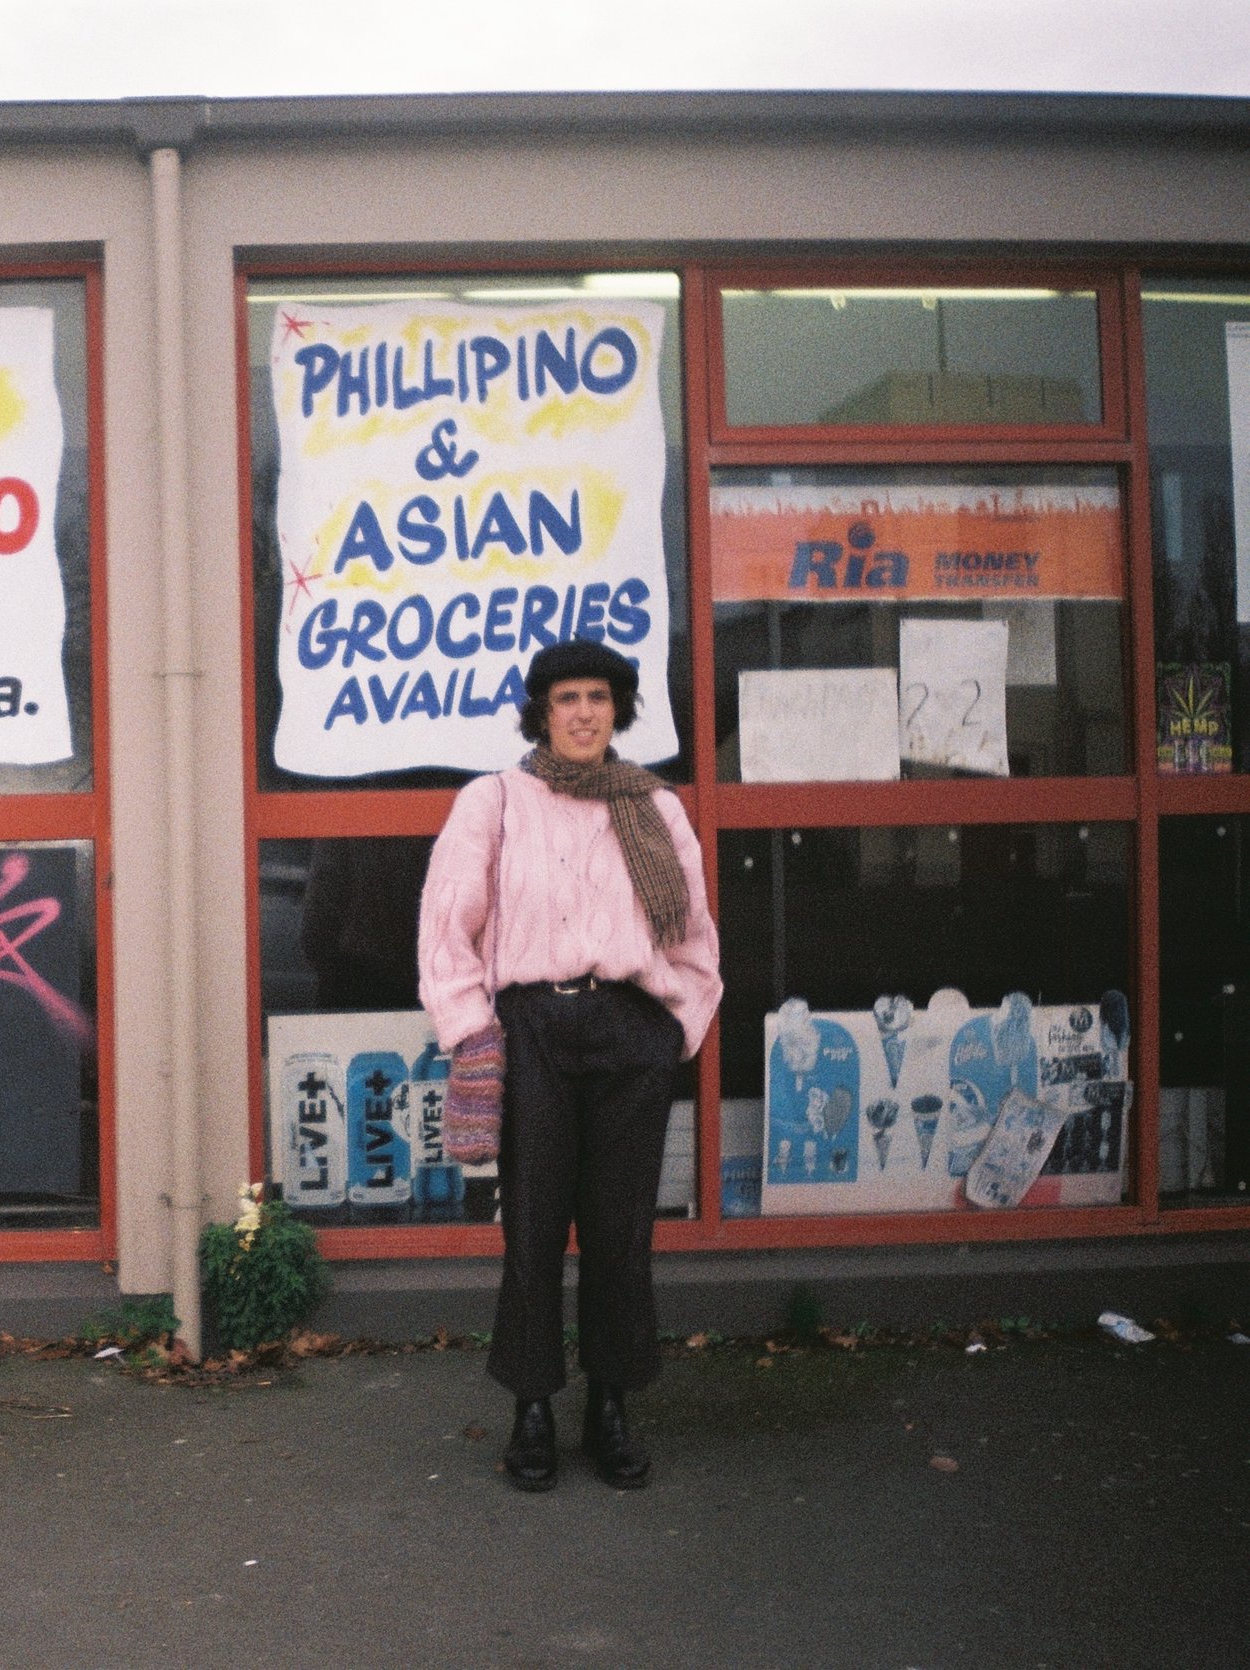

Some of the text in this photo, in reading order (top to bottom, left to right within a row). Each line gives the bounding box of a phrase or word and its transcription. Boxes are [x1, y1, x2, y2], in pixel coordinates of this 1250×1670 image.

[295, 327, 638, 418] PHILLIPINO
[415, 419, 479, 480] &
[334, 489, 582, 574] ASIAN
[788, 521, 910, 590] Ria
[935, 550, 1040, 572] MONEY
[298, 577, 651, 670] GROCERIES
[324, 656, 640, 730] AVAILA
